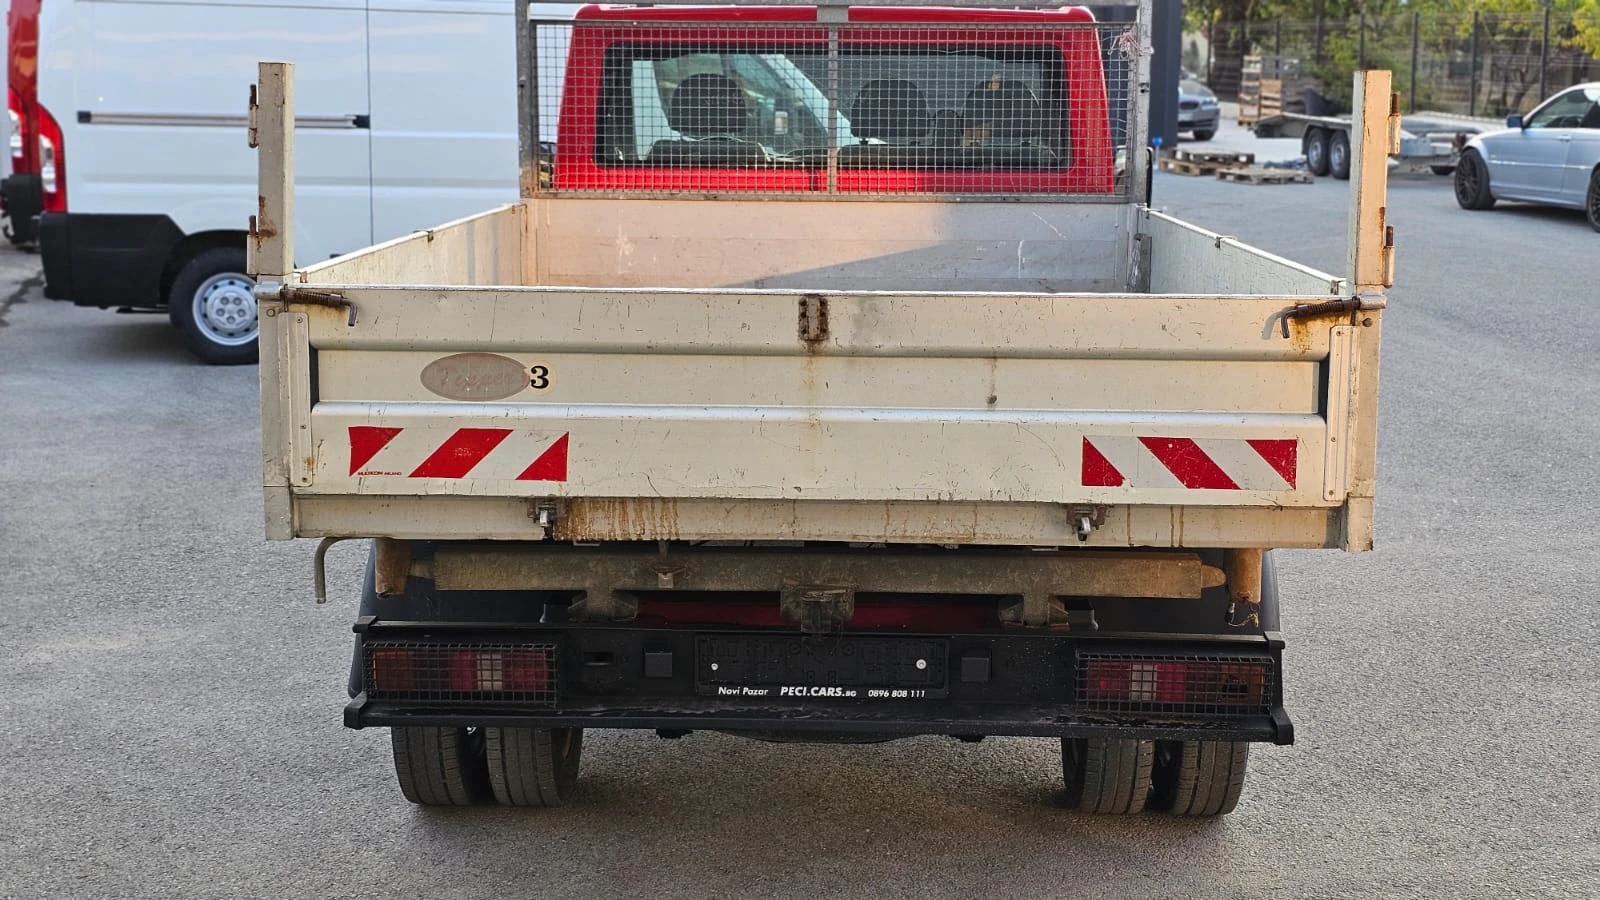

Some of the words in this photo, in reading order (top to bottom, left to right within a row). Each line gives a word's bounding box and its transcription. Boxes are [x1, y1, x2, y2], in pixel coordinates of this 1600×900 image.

[530, 365, 550, 390] 3
[718, 686, 741, 696] Novi
[742, 686, 769, 696] Pazar
[868, 689, 890, 698] 0896
[891, 689, 908, 698] 808
[910, 689, 926, 698] 111
